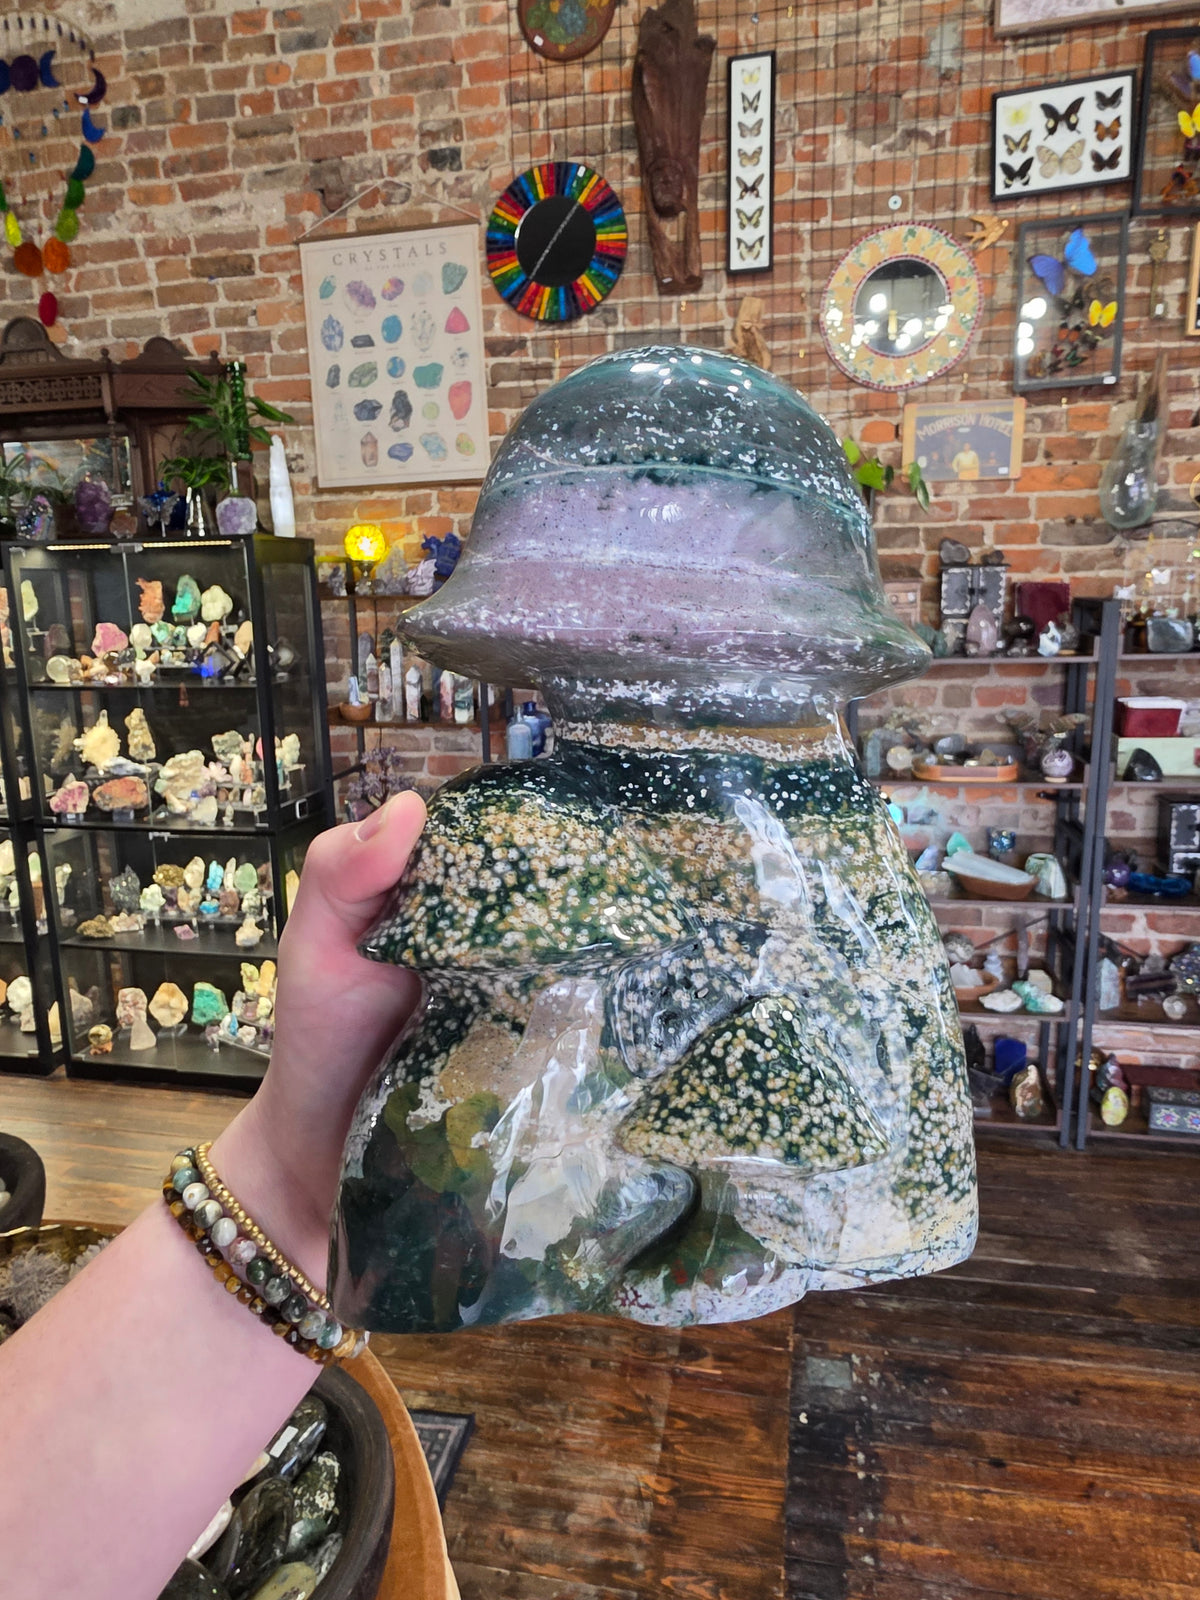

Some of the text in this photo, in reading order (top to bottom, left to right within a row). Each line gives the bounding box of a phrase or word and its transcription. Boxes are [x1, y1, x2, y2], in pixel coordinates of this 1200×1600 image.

[332, 241, 447, 266] CRYSTALS
[916, 413, 1014, 441] MORRISON HOTEL
